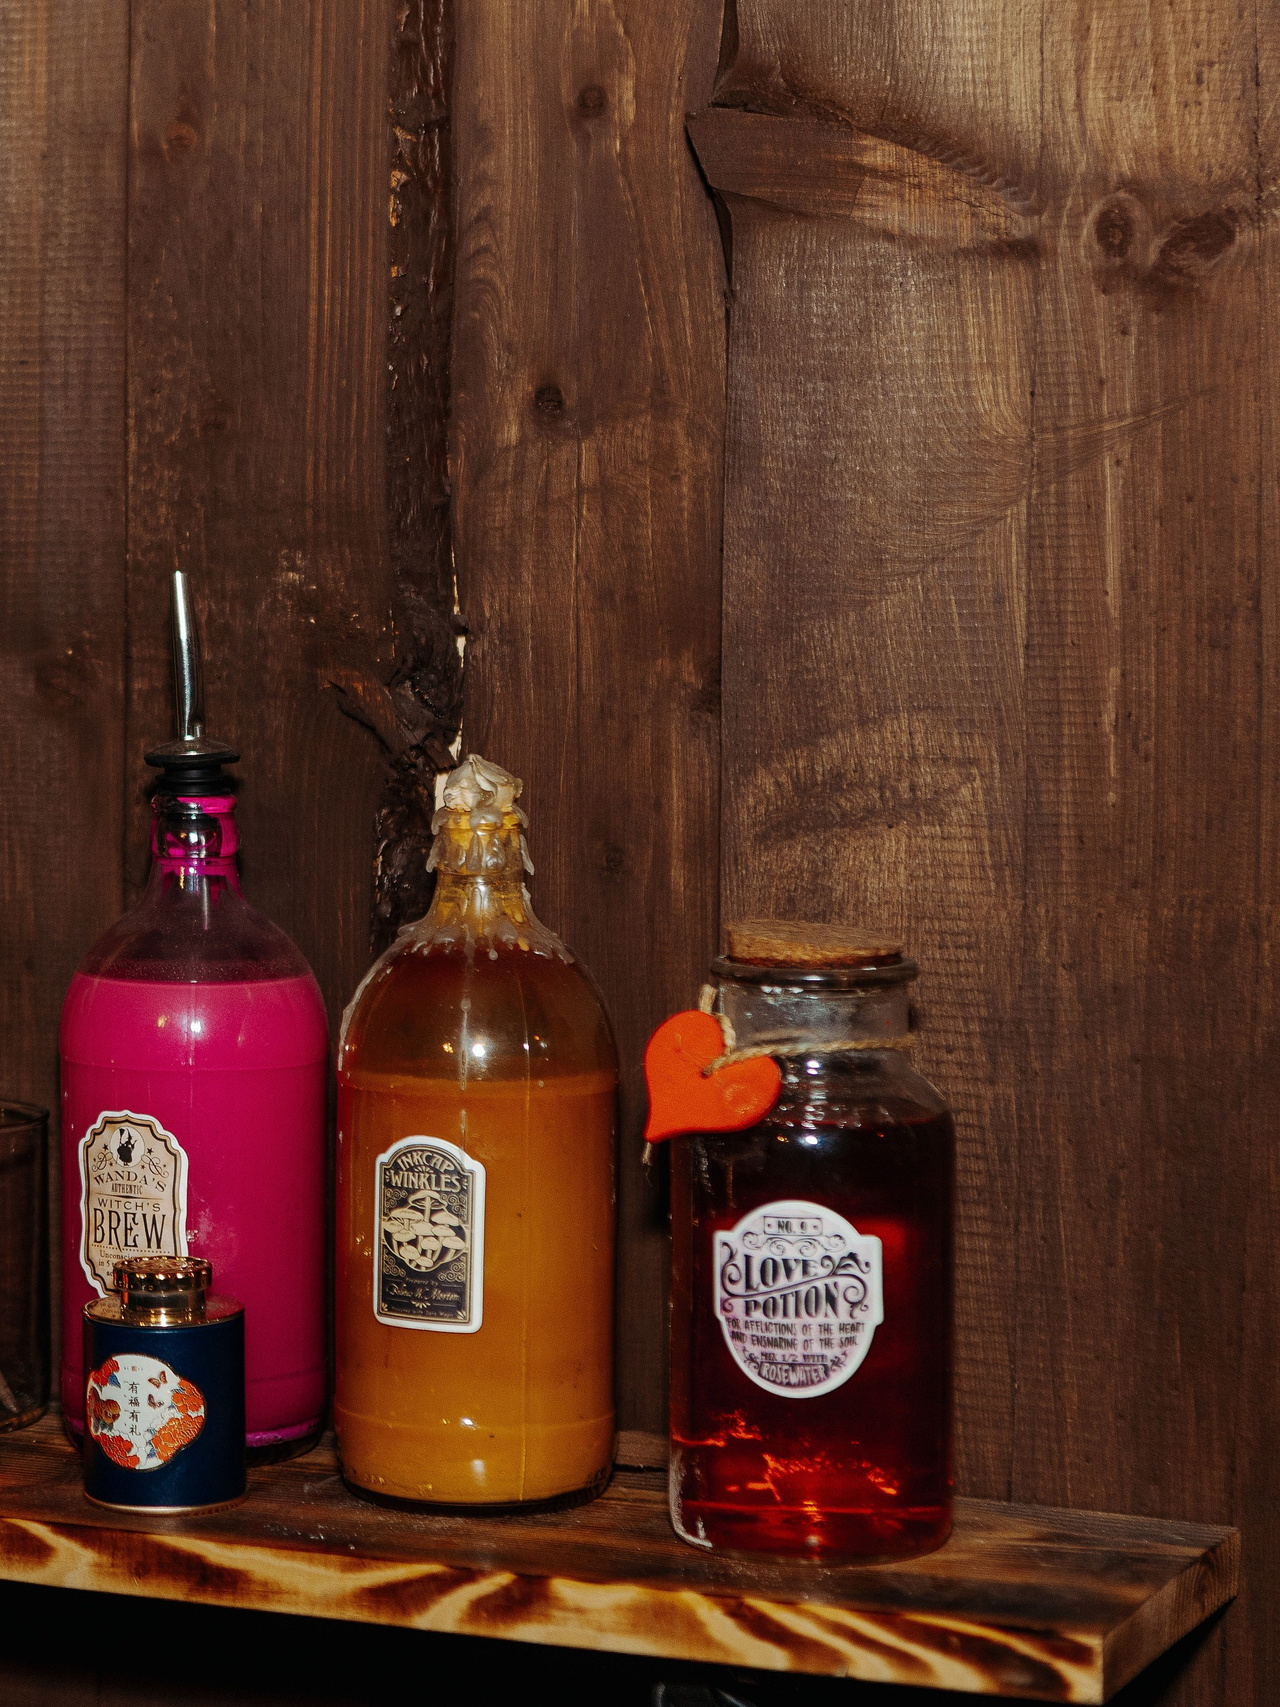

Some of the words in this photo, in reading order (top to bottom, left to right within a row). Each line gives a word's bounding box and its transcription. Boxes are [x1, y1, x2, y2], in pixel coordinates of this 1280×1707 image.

[396, 1150, 455, 1173] INKCAP
[93, 1170, 167, 1193] WANDA'S
[111, 1183, 144, 1195] AUTHENTIC
[390, 1168, 462, 1193] WINKLES
[97, 1197, 161, 1213] WITCH'S
[93, 1208, 166, 1252] BREW
[777, 1220, 795, 1234] NO.
[800, 1220, 807, 1234] 9
[100, 1249, 137, 1261] Unconscio
[743, 1254, 820, 1293] LOVE
[743, 1281, 840, 1320] POTION
[726, 1317, 740, 1330] FOR
[744, 1319, 797, 1336] AFFLICTIONS
[801, 1323, 813, 1336] OF
[818, 1323, 834, 1335] THE
[838, 1321, 866, 1334] HEART
[730, 1330, 748, 1344] AND
[802, 1339, 813, 1351] OF
[819, 1336, 834, 1349] THE
[839, 1335, 859, 1348] SOUL
[781, 1353, 799, 1362] 1/2
[760, 1363, 826, 1386] ROSEWATER
[128, 1381, 141, 1437] 有福有礼
